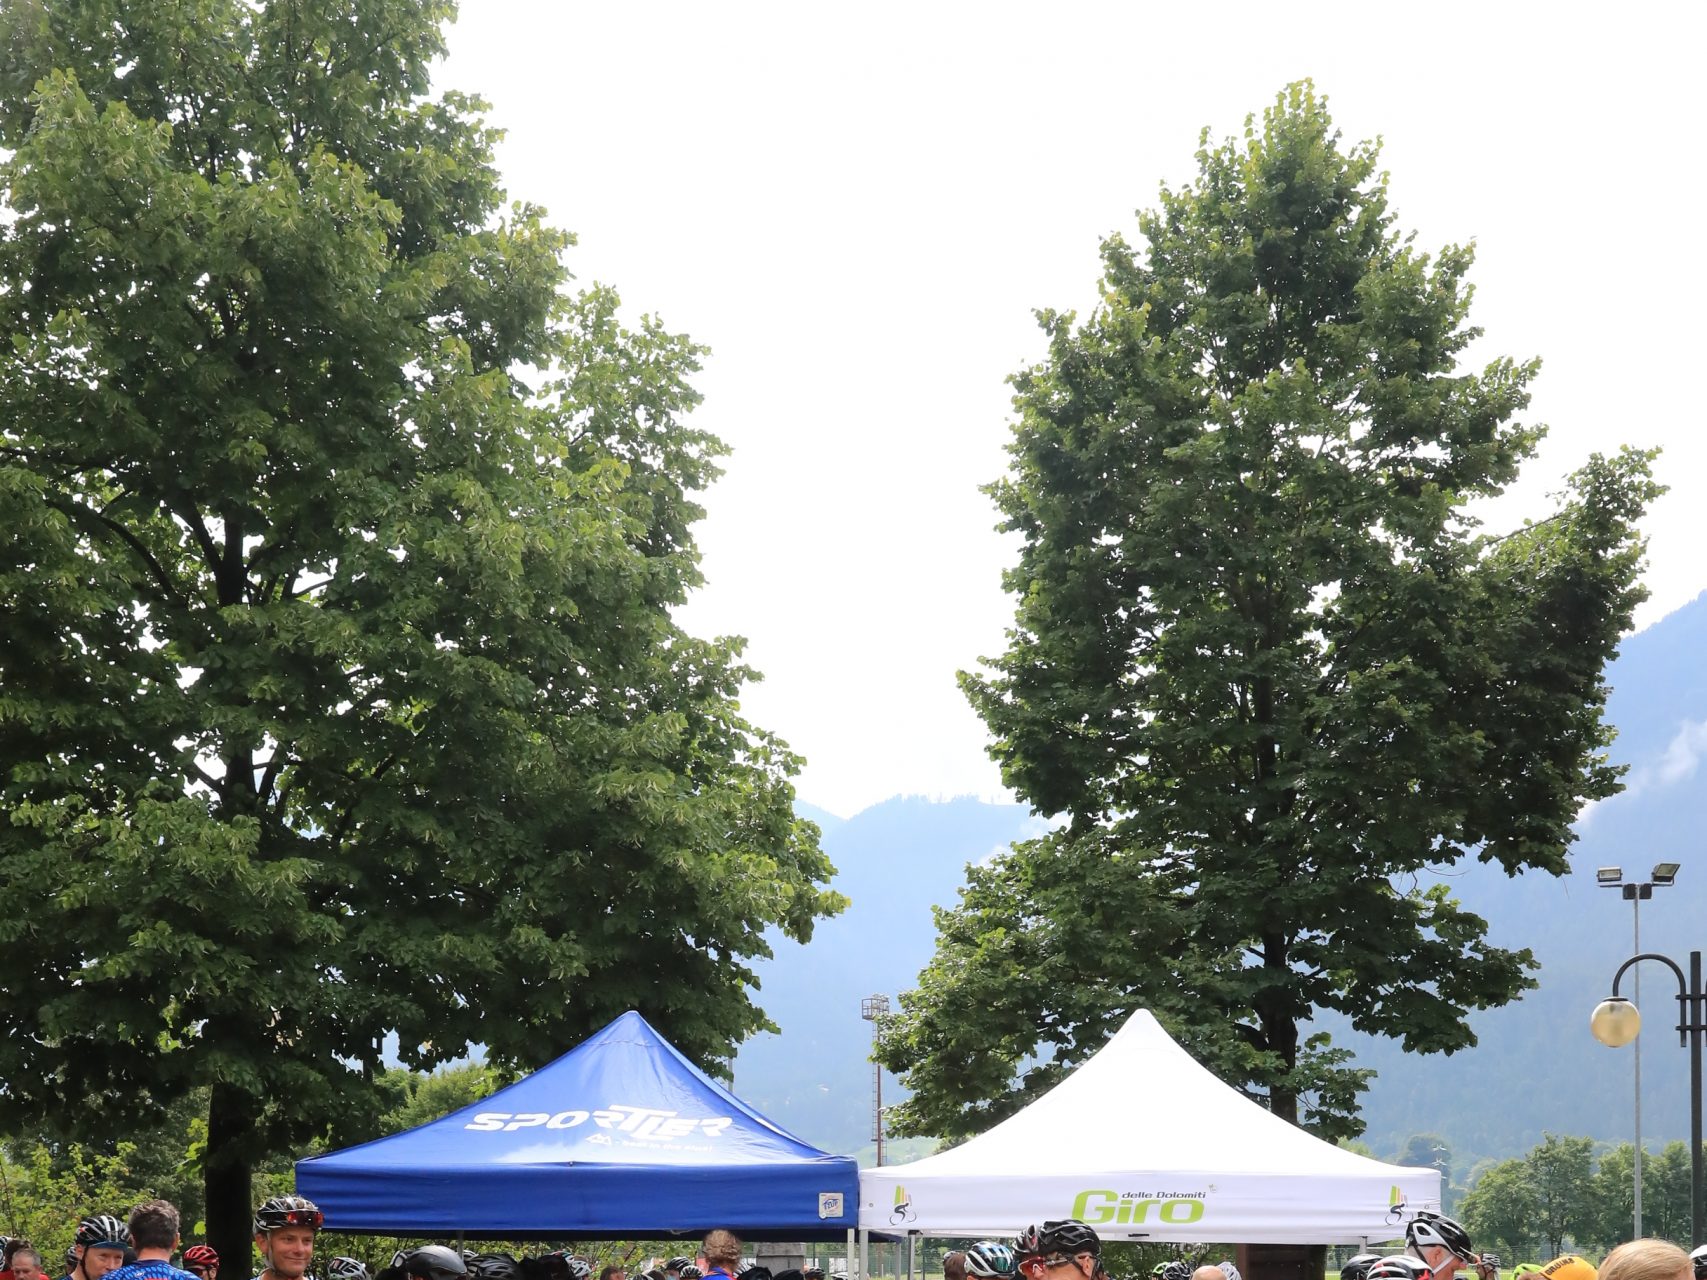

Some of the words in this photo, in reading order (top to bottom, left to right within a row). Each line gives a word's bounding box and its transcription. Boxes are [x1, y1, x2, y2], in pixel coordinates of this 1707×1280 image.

[465, 1104, 733, 1141] SPORTLER
[1071, 1189, 1205, 1224] Giro
[1121, 1191, 1153, 1199] delle
[1156, 1191, 1207, 1199] Dolomiti
